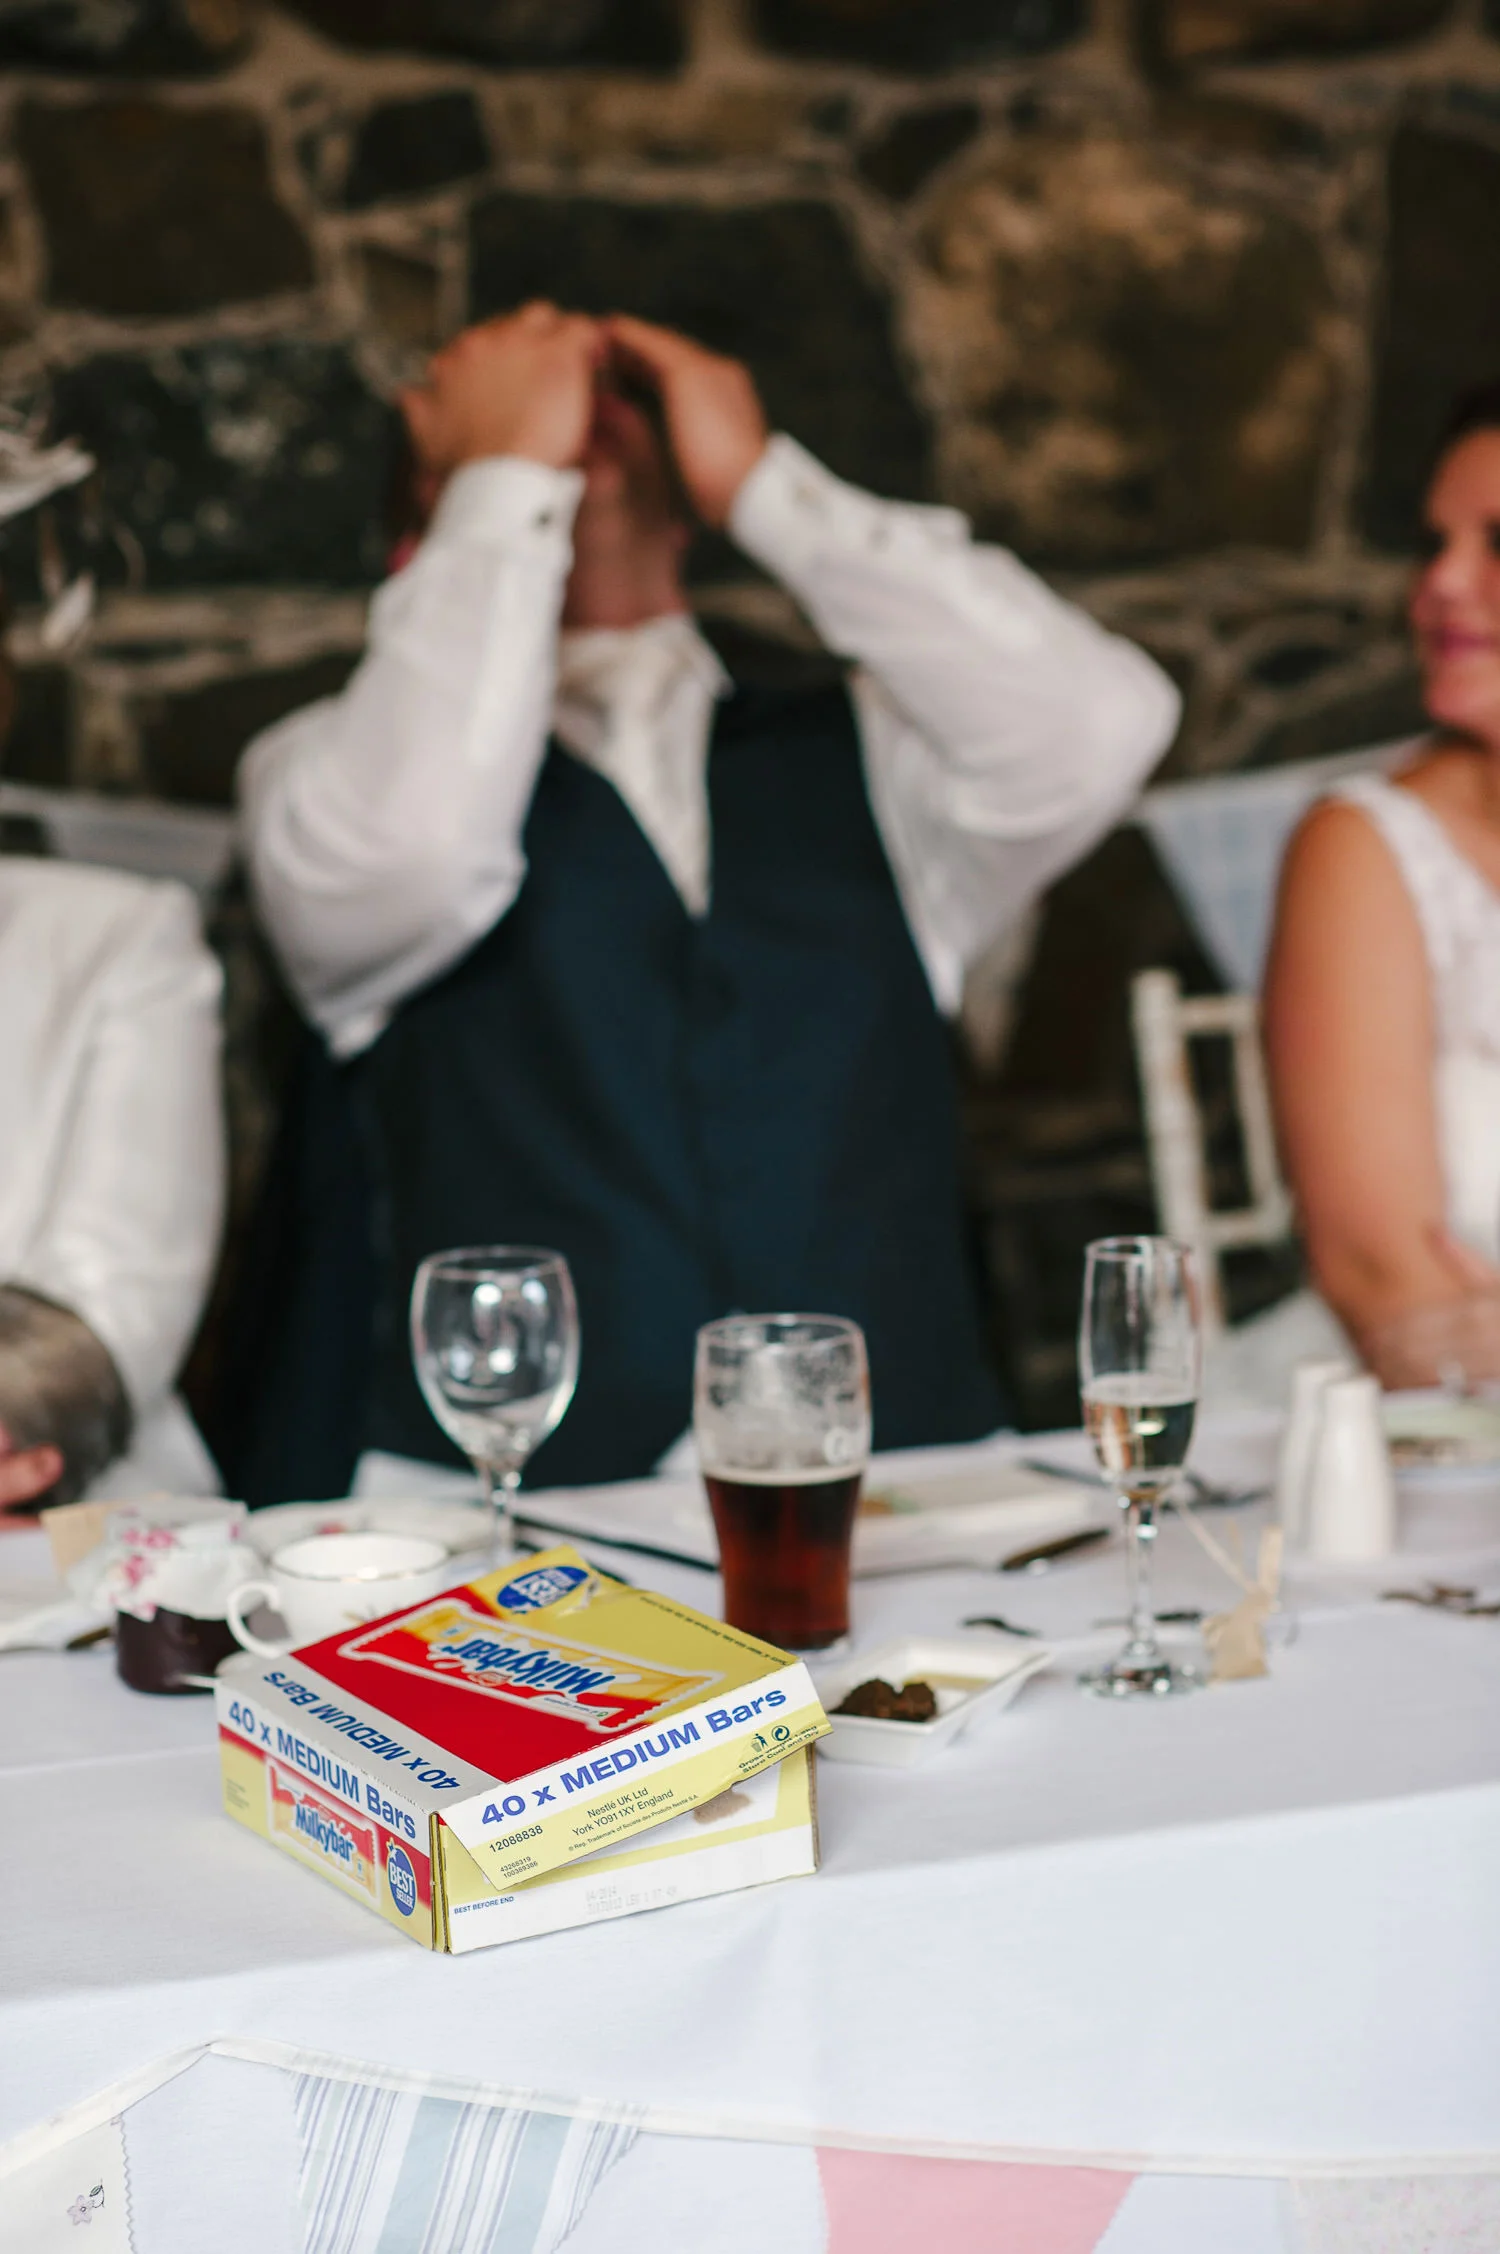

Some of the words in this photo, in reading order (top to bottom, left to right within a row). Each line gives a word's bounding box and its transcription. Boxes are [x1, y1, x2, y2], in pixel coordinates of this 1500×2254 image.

[440, 1639, 616, 1694] Milkybar
[262, 1670, 320, 1707] Bars
[307, 1703, 411, 1762] MEDIUM
[228, 1701, 255, 1733] 40
[260, 1721, 271, 1747] x
[277, 1727, 360, 1803] MEDIUM
[366, 1783, 416, 1839] Bars
[402, 1757, 430, 1771] x
[482, 1795, 525, 1825] 40
[532, 1785, 557, 1806] x
[560, 1722, 701, 1794] MEDIUM
[705, 1689, 787, 1734] Bars
[416, 1769, 461, 1791] 40
[572, 1823, 595, 1837] York
[638, 1789, 675, 1810] England
[587, 1800, 616, 1818] Nestlé
[617, 1793, 632, 1807] UK
[632, 1787, 649, 1801] Ltd
[294, 1803, 354, 1862] Milkybar
[489, 1825, 544, 1853] 12088838
[389, 1861, 414, 1896] BEST
[454, 1905, 471, 1915] BEST
[472, 1899, 499, 1911] BEFORE
[499, 1895, 515, 1904] END
